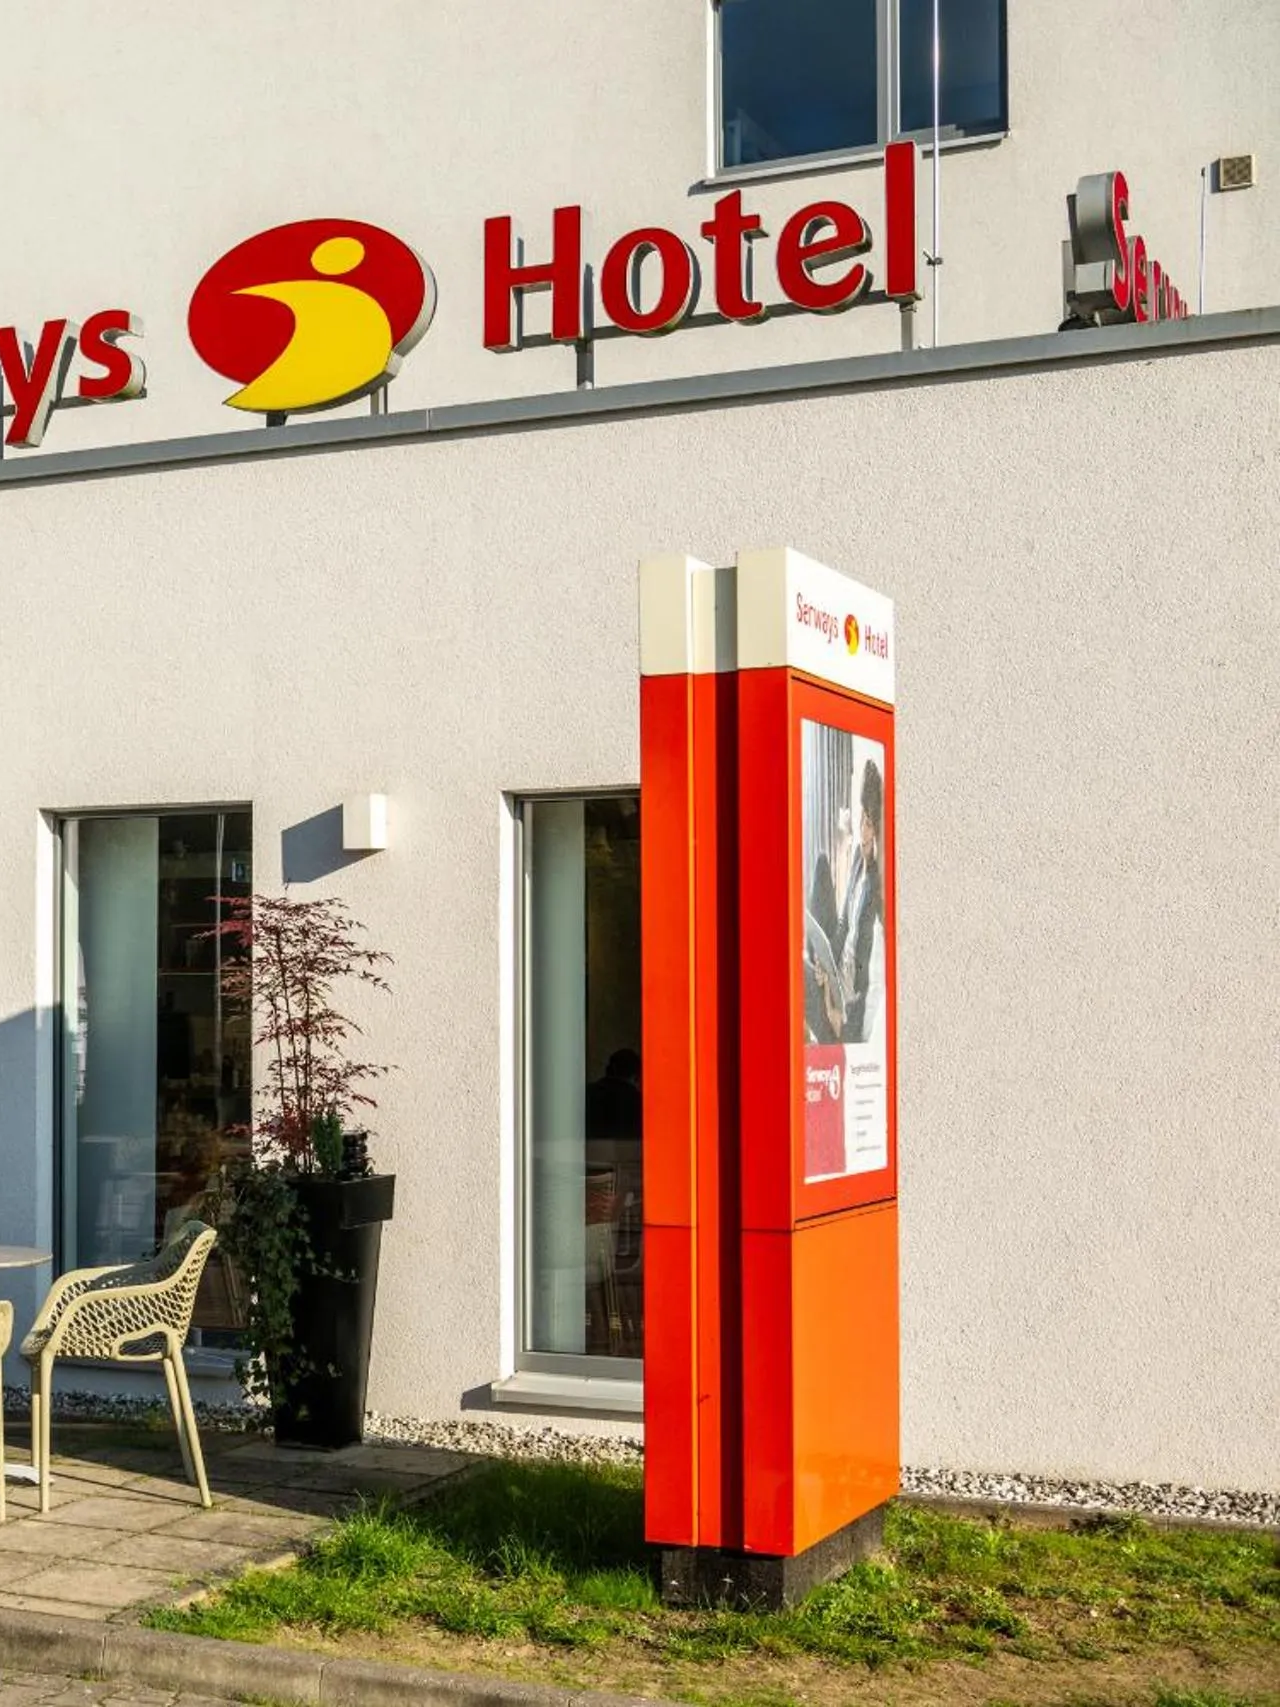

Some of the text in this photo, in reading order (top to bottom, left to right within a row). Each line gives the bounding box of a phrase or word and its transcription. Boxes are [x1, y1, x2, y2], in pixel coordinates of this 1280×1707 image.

[484, 140, 918, 351] Hotel
[796, 591, 888, 659] Serways Hotel
